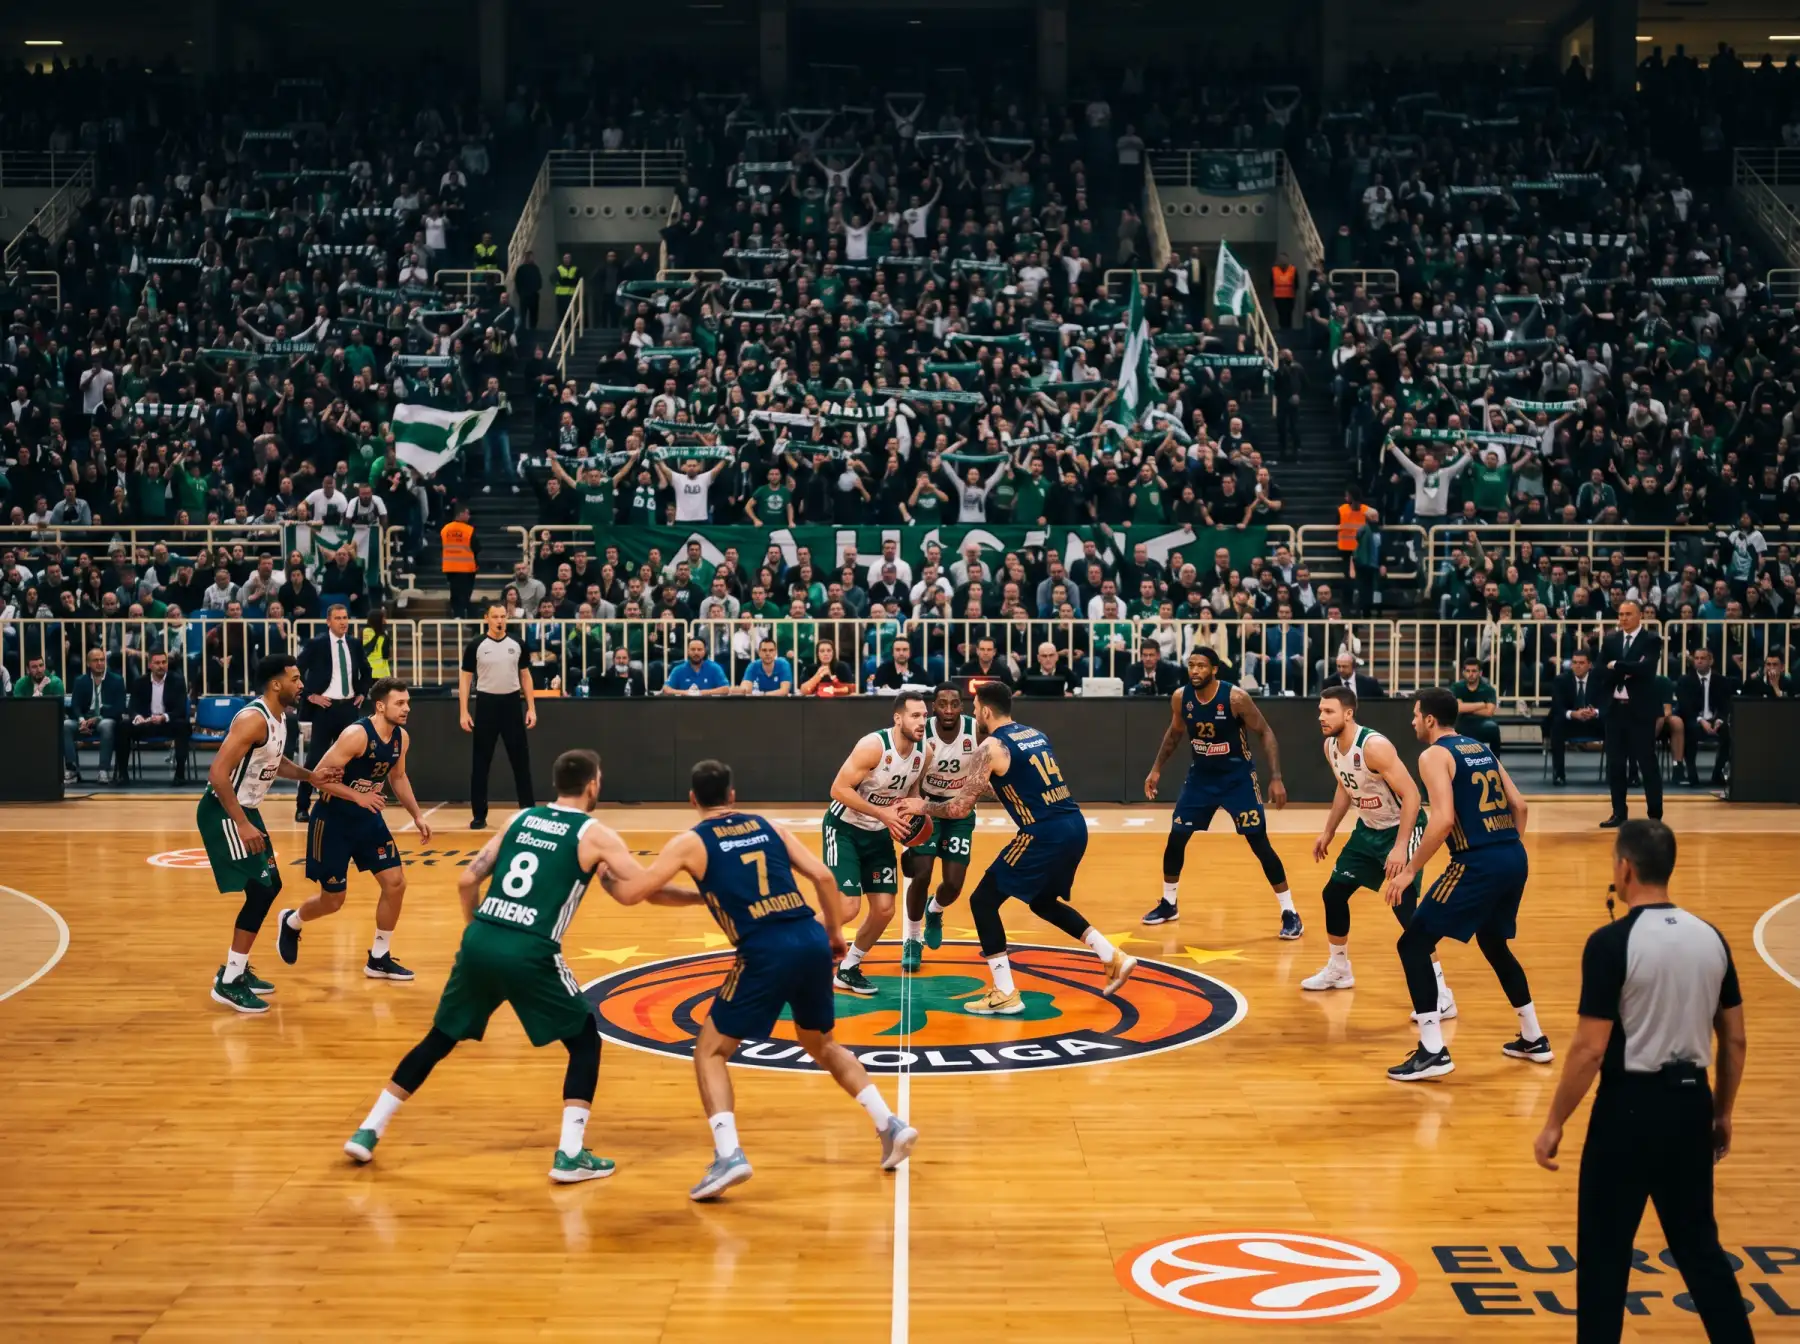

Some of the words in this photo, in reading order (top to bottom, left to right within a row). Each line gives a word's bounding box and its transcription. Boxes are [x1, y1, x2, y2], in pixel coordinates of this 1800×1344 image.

[1195, 722, 1216, 739] 23
[937, 759, 961, 774] 23
[1028, 750, 1064, 787] 14
[887, 774, 908, 790] 21
[1340, 771, 1359, 790] 35
[1471, 769, 1508, 813] 23
[1239, 809, 1261, 828] 23
[385, 840, 396, 859] 7
[948, 836, 970, 855] 35
[501, 851, 540, 898] 8
[740, 850, 771, 897] 7
[478, 897, 538, 926] ATHENS
[748, 892, 806, 920] MADRID
[689, 1037, 1121, 1067] UOLIGA
